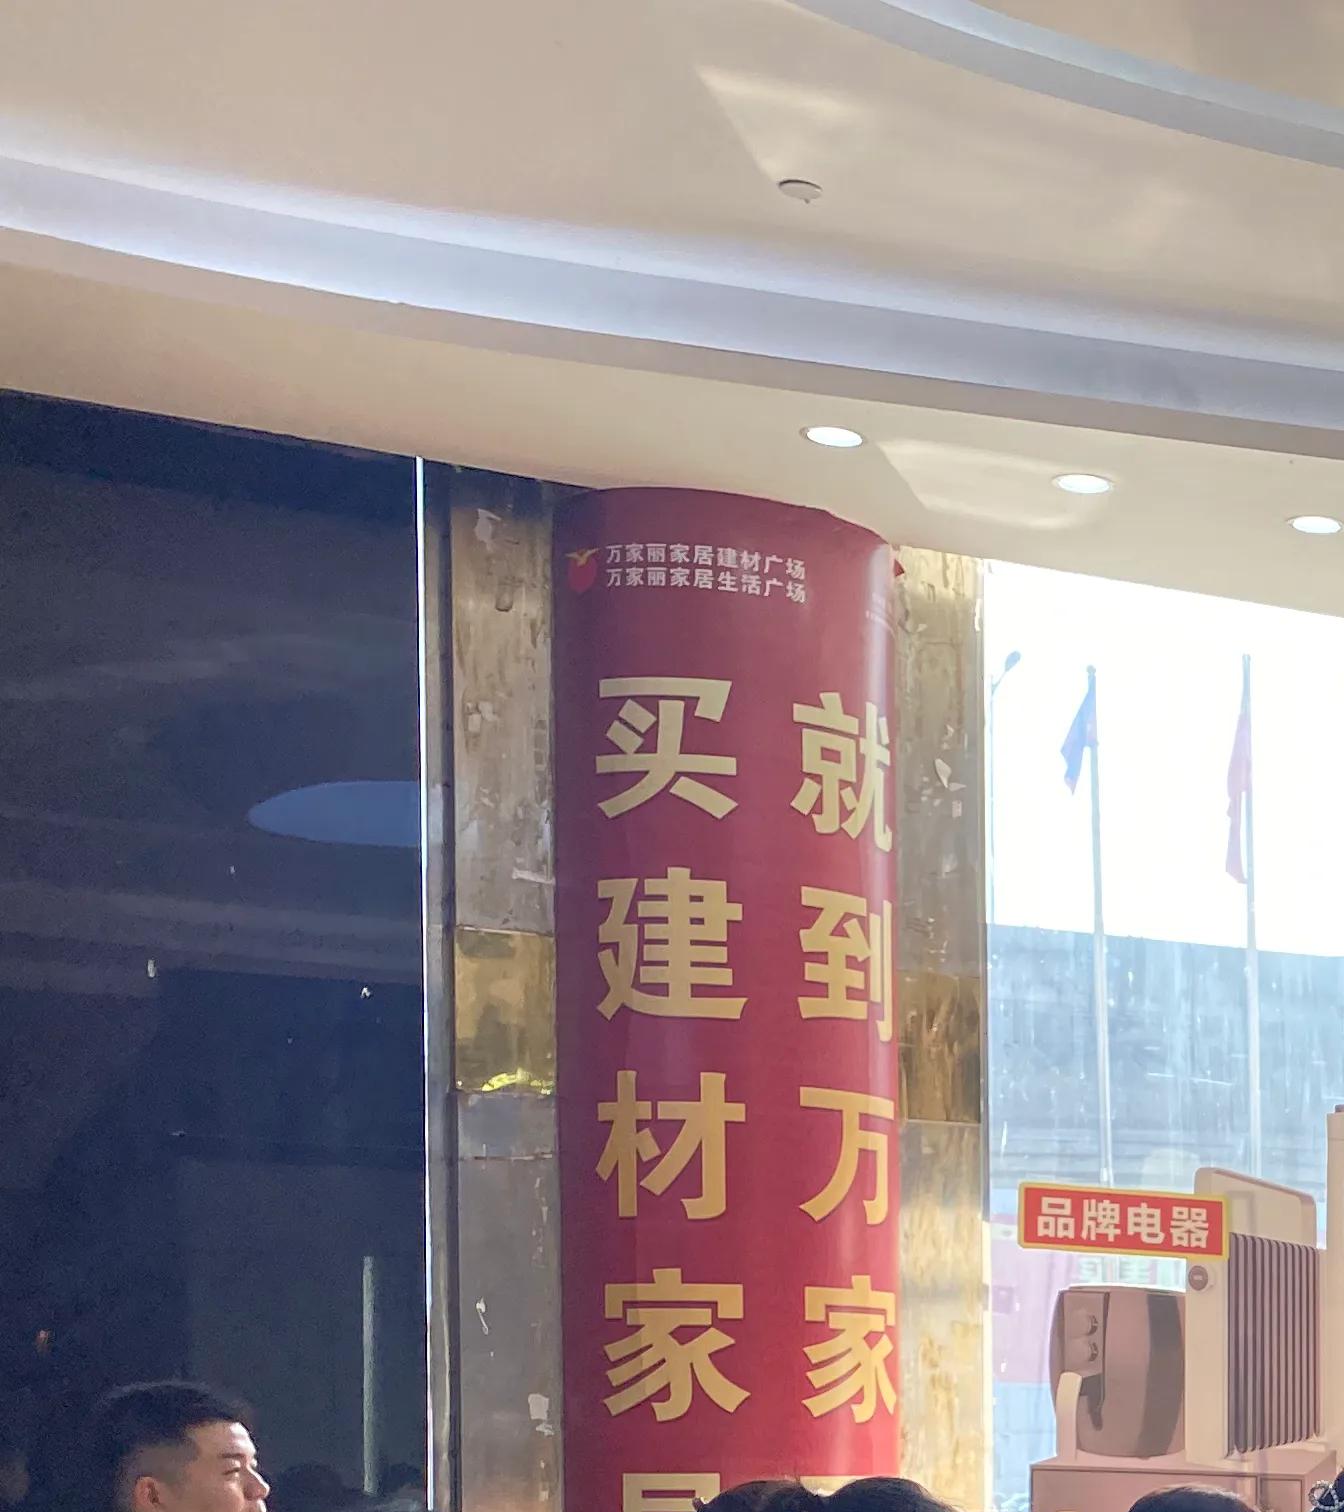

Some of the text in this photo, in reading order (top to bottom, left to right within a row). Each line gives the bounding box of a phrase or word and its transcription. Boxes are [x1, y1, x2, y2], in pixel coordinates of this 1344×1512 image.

[606, 543, 806, 580] 万家丽家居建材广场
[606, 567, 807, 604] 万家丽家居生活广场
[790, 692, 899, 1493] 就到万家
[1037, 1196, 1209, 1249] 品牌电器
